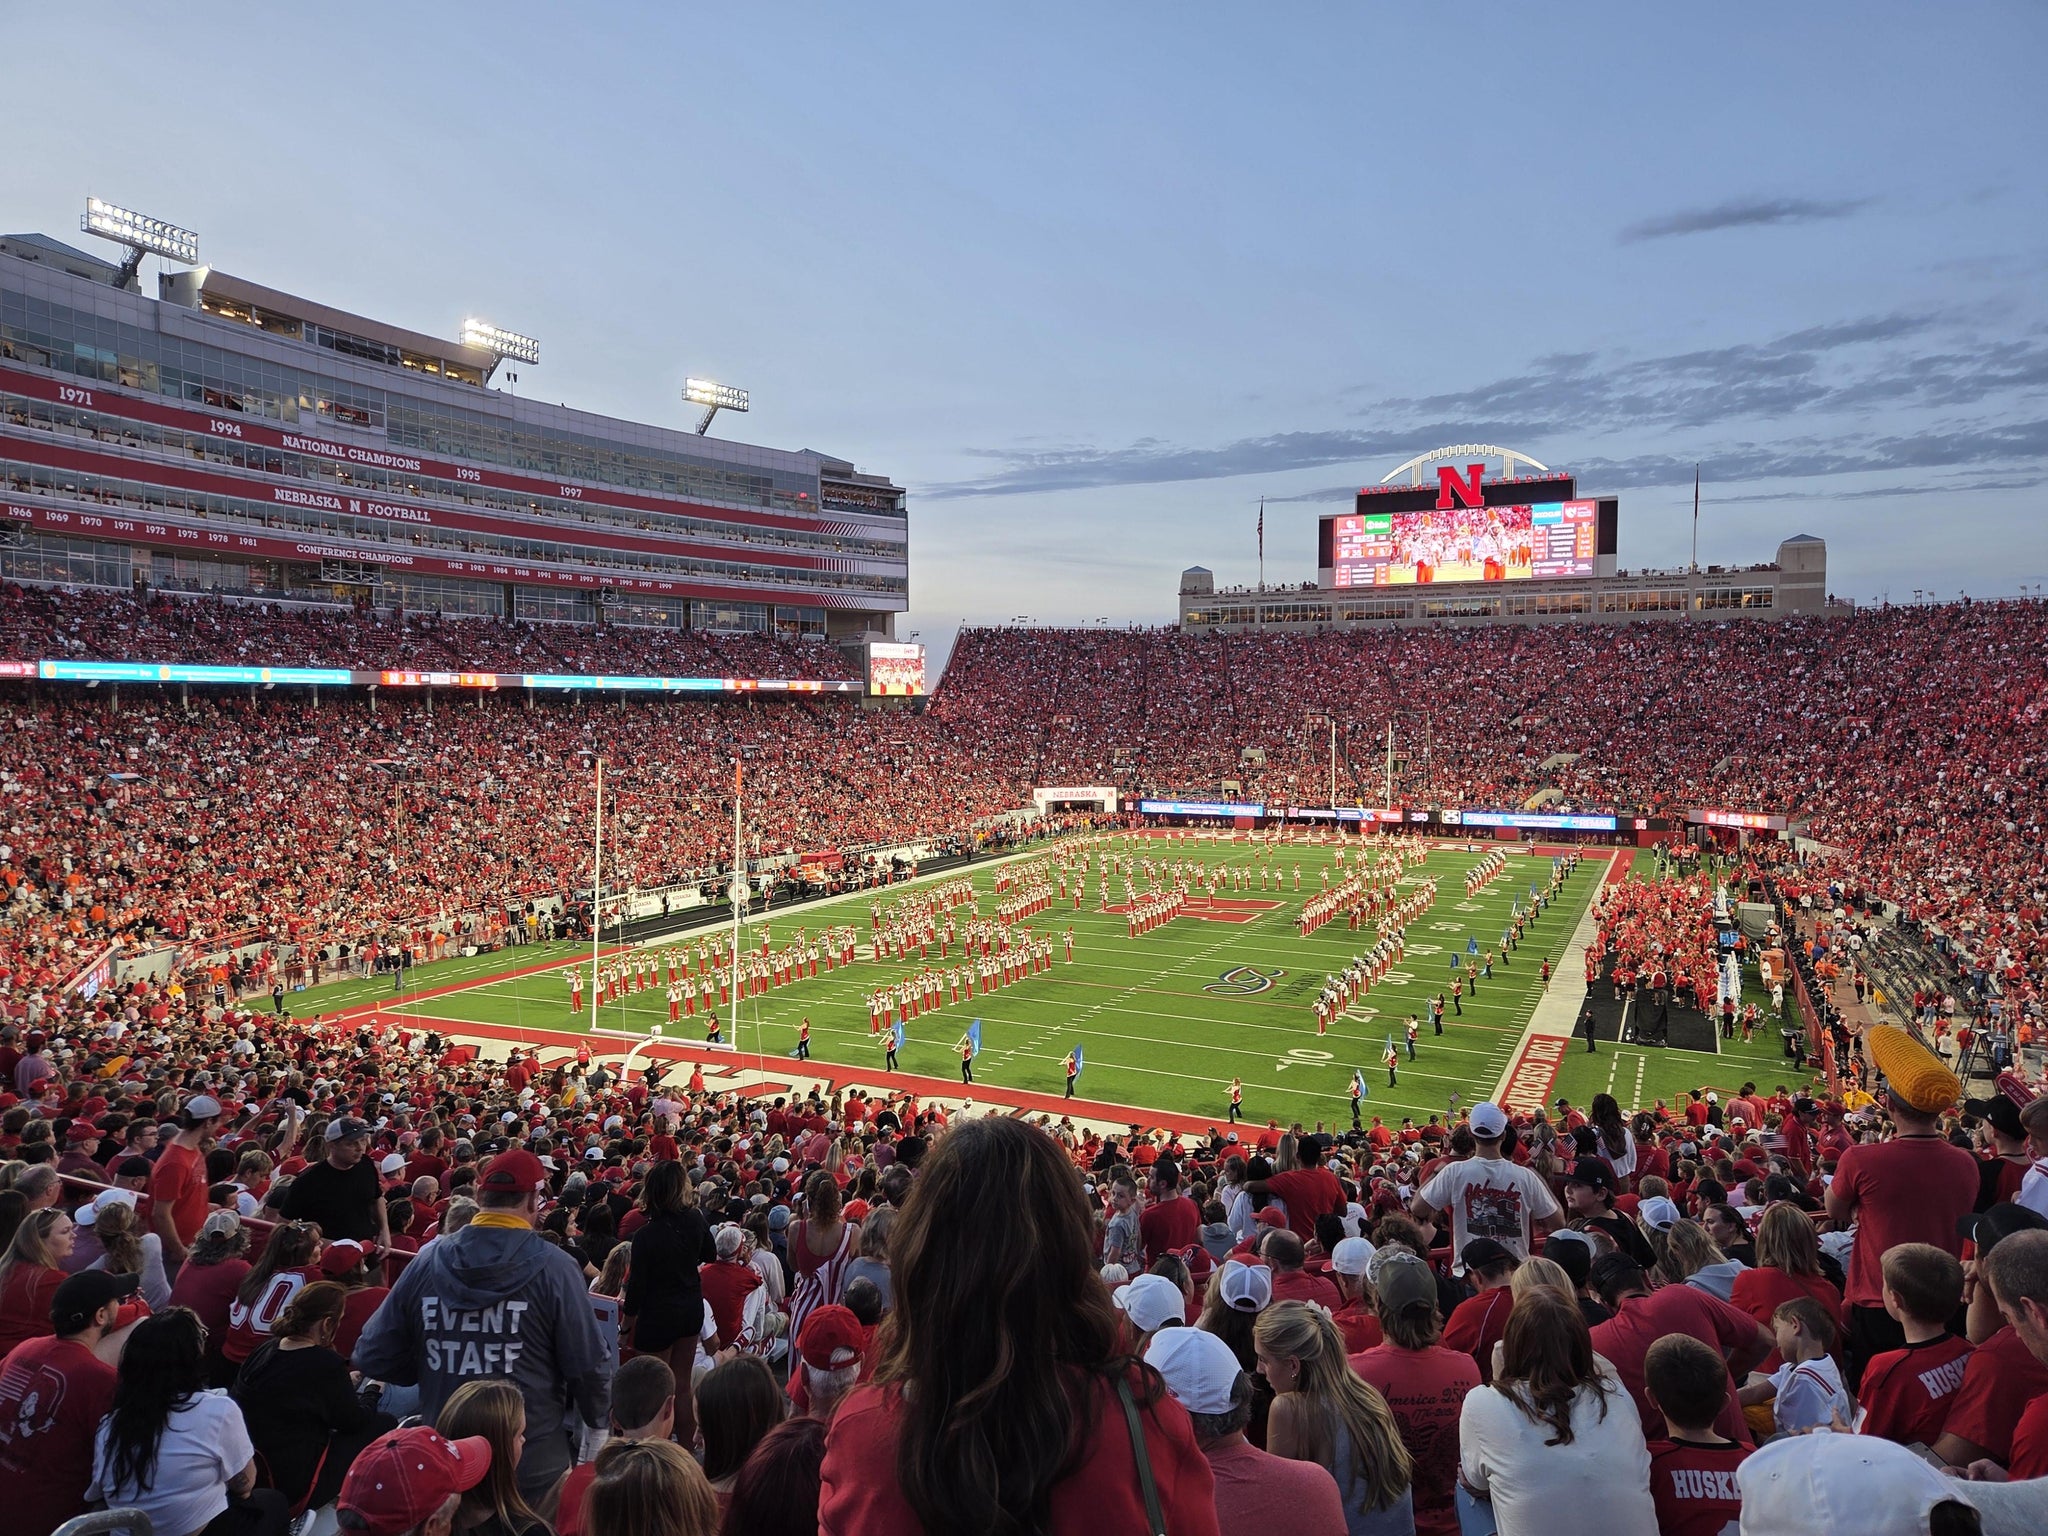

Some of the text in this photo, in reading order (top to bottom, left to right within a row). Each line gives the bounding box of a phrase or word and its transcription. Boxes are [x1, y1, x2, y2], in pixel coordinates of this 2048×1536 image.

[59, 386, 92, 406] 1971
[210, 419, 242, 437] 1994
[282, 435, 421, 471] NATIONAL CHAMPIONS
[456, 467, 481, 482] 1995
[560, 486, 582, 499] 1997
[1436, 463, 1486, 510] N
[1491, 472, 1569, 486] STADIUM
[274, 488, 431, 523] NEBRASKA N FOOTBALL
[8, 506, 257, 547] 1966 1969 1970 1971 1972 1975 1978 1981
[296, 544, 414, 565] CONFERENCE CHAMPIONS
[447, 560, 463, 570] 1982
[558, 572, 573, 581] 1992
[579, 574, 594, 583] 1993
[1525, 1039, 1564, 1062] TOM
[421, 1296, 528, 1334] EVENT
[426, 1338, 524, 1376] STAFF
